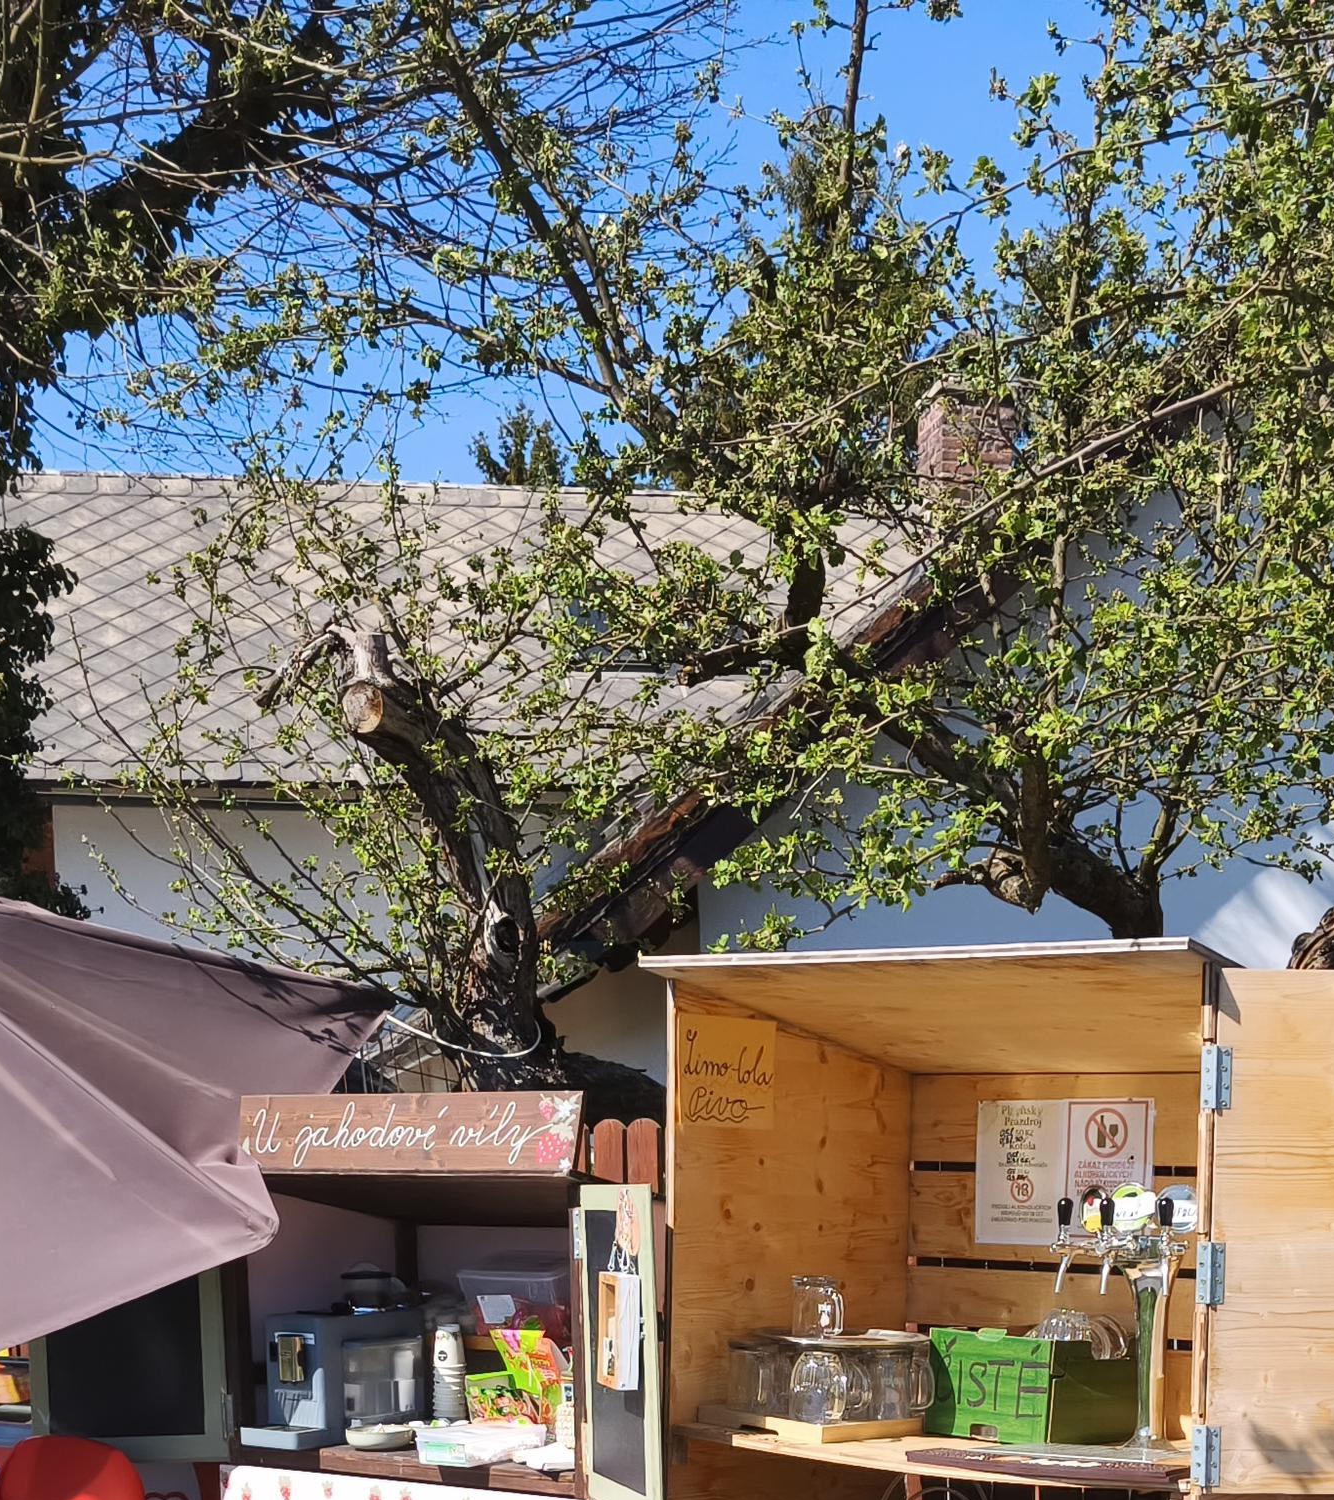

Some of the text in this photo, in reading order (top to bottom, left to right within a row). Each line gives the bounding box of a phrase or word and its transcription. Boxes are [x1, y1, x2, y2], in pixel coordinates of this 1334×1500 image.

[687, 1086, 749, 1119] Pivo
[252, 1101, 553, 1167] U jahodové víly
[1004, 1117, 1042, 1129] Prazdroj
[1015, 1183, 1029, 1197] 18
[937, 1335, 1051, 1420] ČISTÉ
